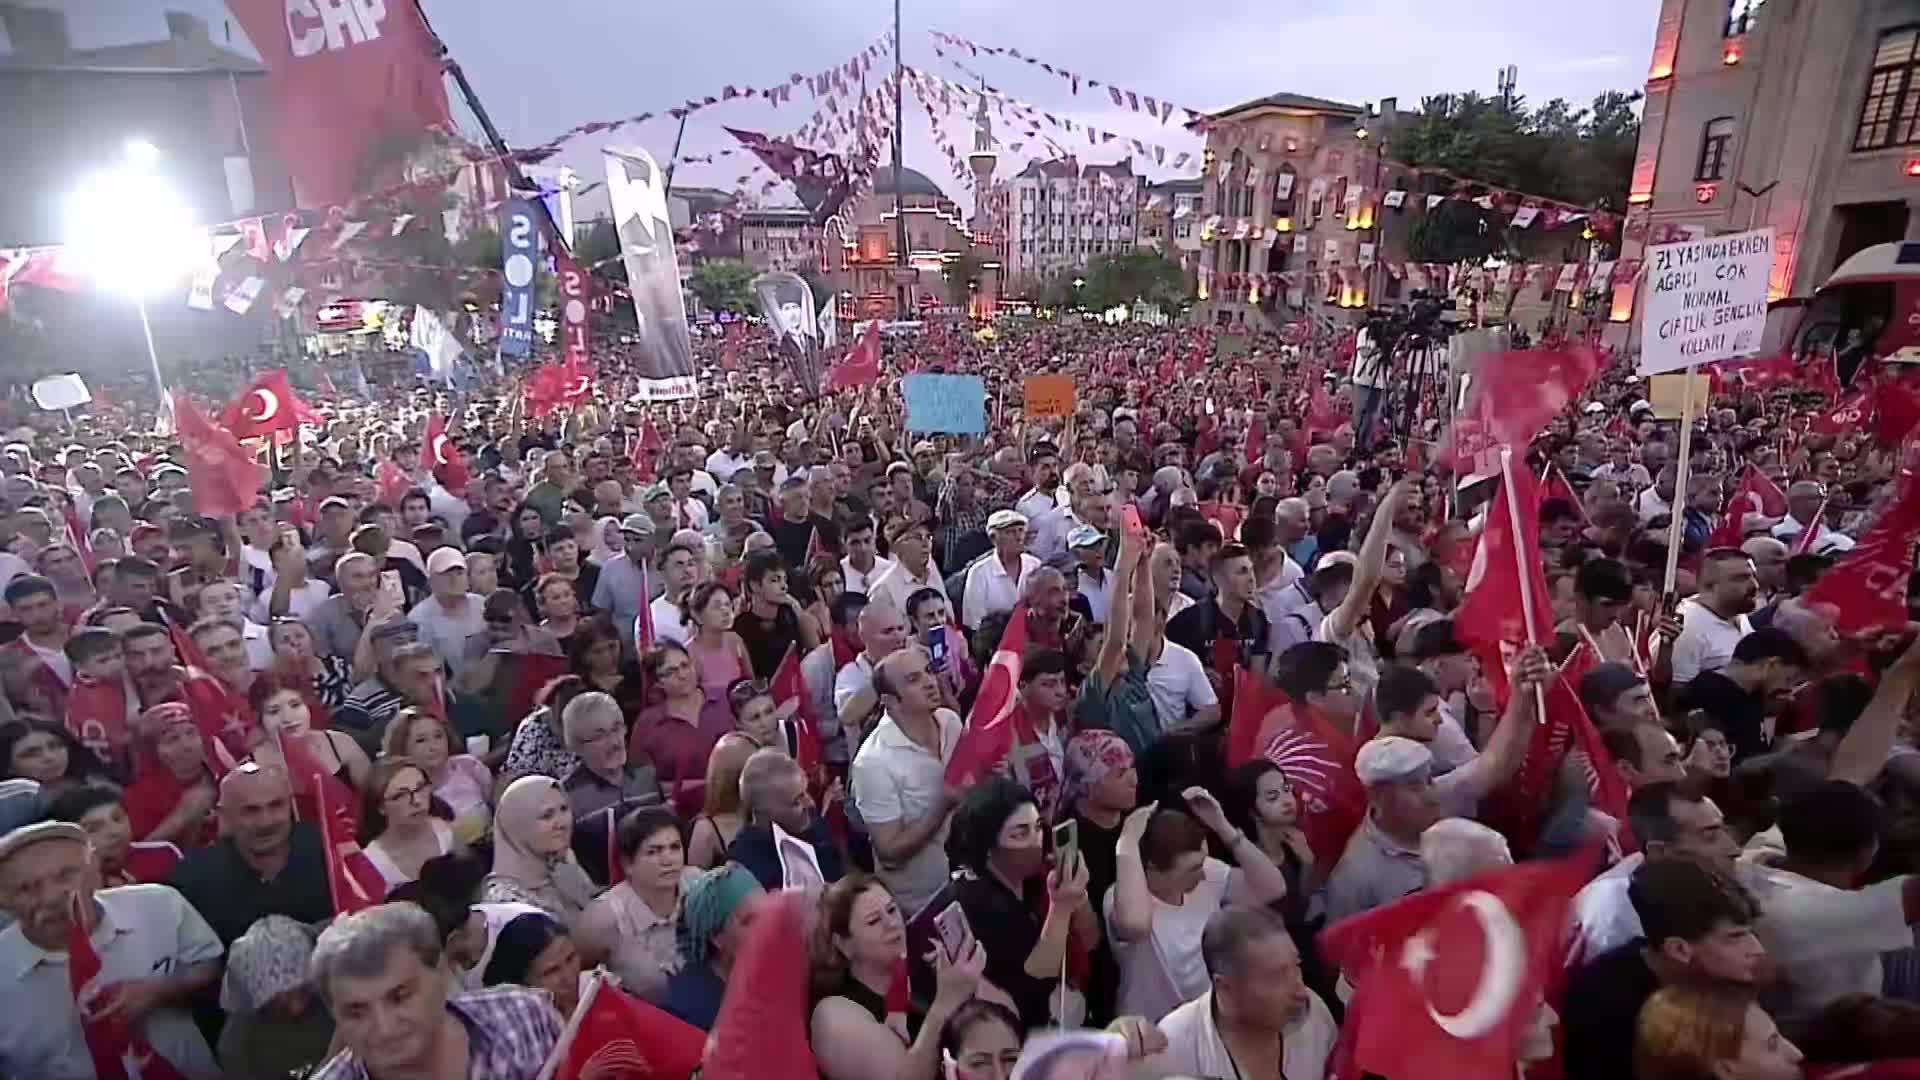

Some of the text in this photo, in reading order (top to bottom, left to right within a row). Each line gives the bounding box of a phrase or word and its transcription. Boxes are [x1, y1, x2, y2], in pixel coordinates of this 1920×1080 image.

[284, 0, 388, 57] CHP
[1656, 248, 1672, 271] 71
[1684, 290, 1731, 309] NORMAL
